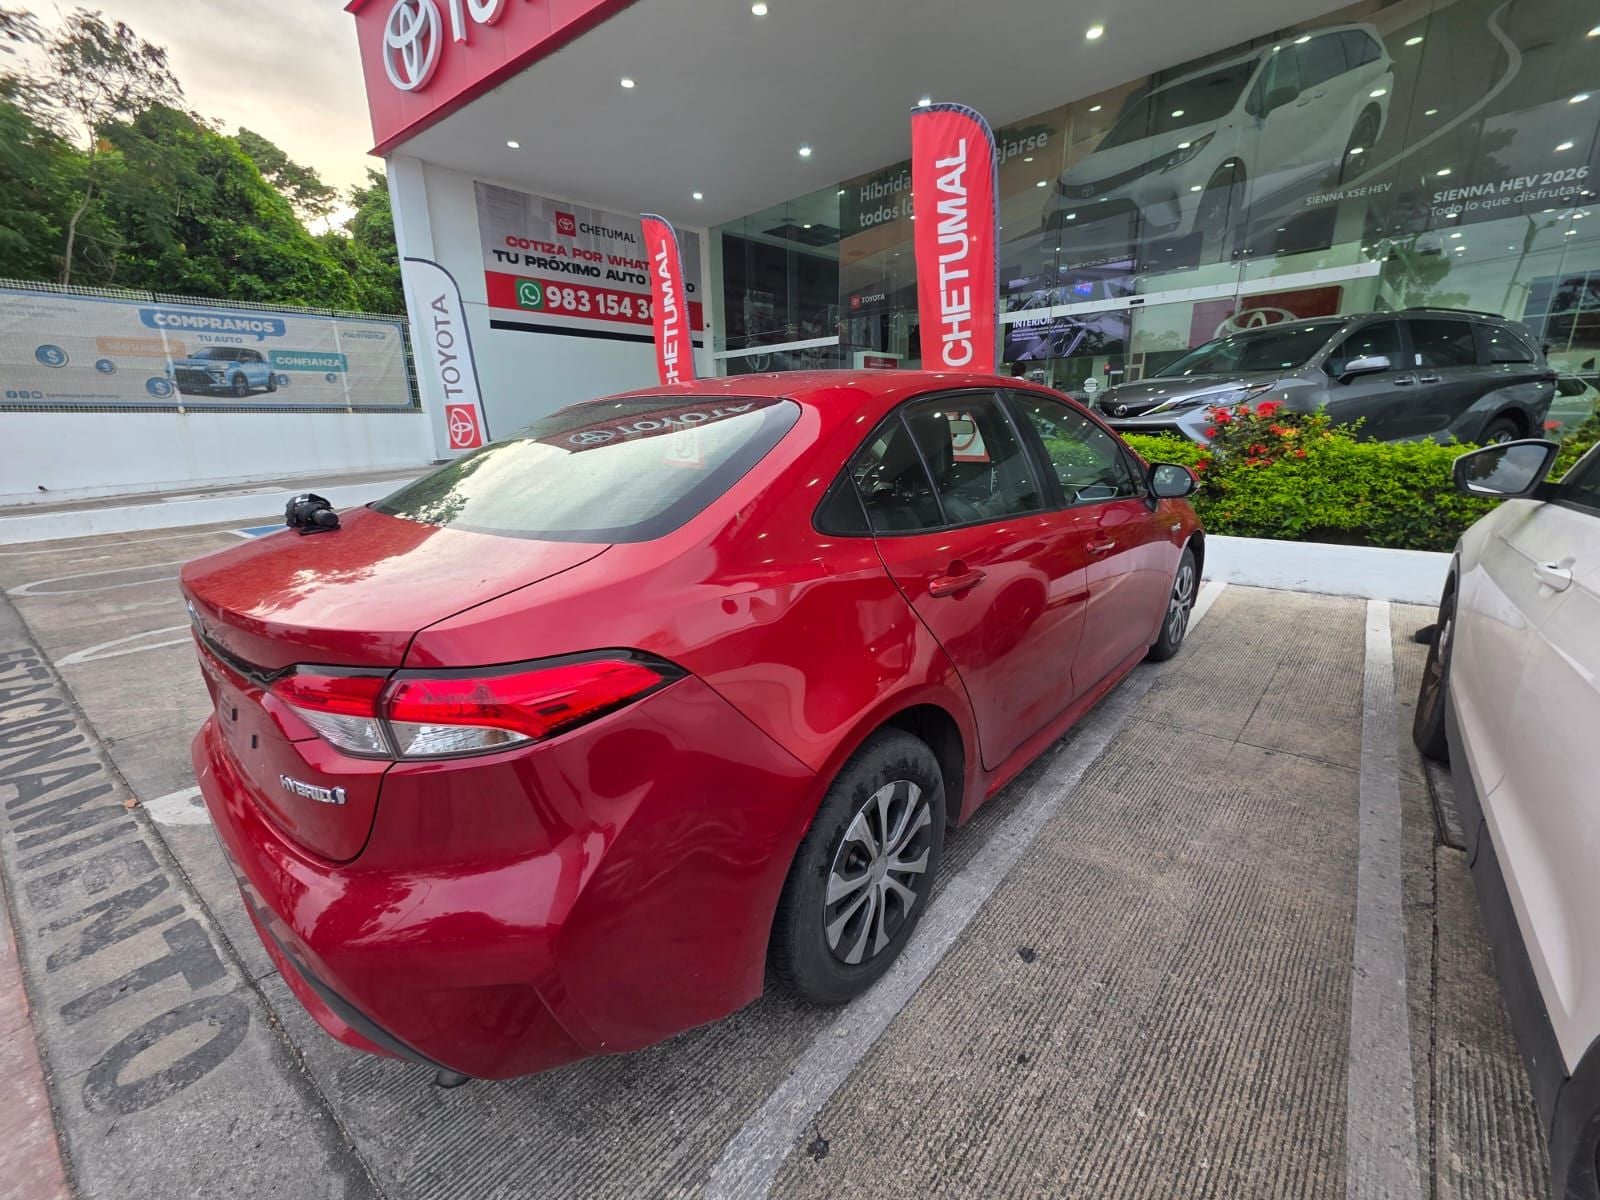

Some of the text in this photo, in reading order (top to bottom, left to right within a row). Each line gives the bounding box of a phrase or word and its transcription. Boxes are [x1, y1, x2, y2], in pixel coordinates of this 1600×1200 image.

[1305, 182, 1392, 206] SIENNA XSE HEV
[1433, 165, 1589, 204] SIENNA HEV 2026
[1430, 183, 1584, 217] Todo lo que disfrutas
[859, 203, 899, 227] todos
[579, 222, 637, 244] CHETUMAL
[505, 235, 568, 257] COTIZA
[572, 247, 604, 263] POR
[935, 138, 973, 367] CHETUMAL
[493, 249, 520, 265] TU
[525, 251, 601, 278] PRÓXIMO
[606, 269, 646, 286] AUTO
[546, 285, 592, 312] 983
[595, 292, 633, 318] 154
[862, 293, 885, 303] TOYOTA
[153, 313, 275, 333] COMPRAMOS
[198, 334, 243, 344] TU AUTO
[431, 294, 463, 399] TOYOTA
[275, 356, 343, 369] CONFIANZA
[280, 774, 333, 803] HYBRID
